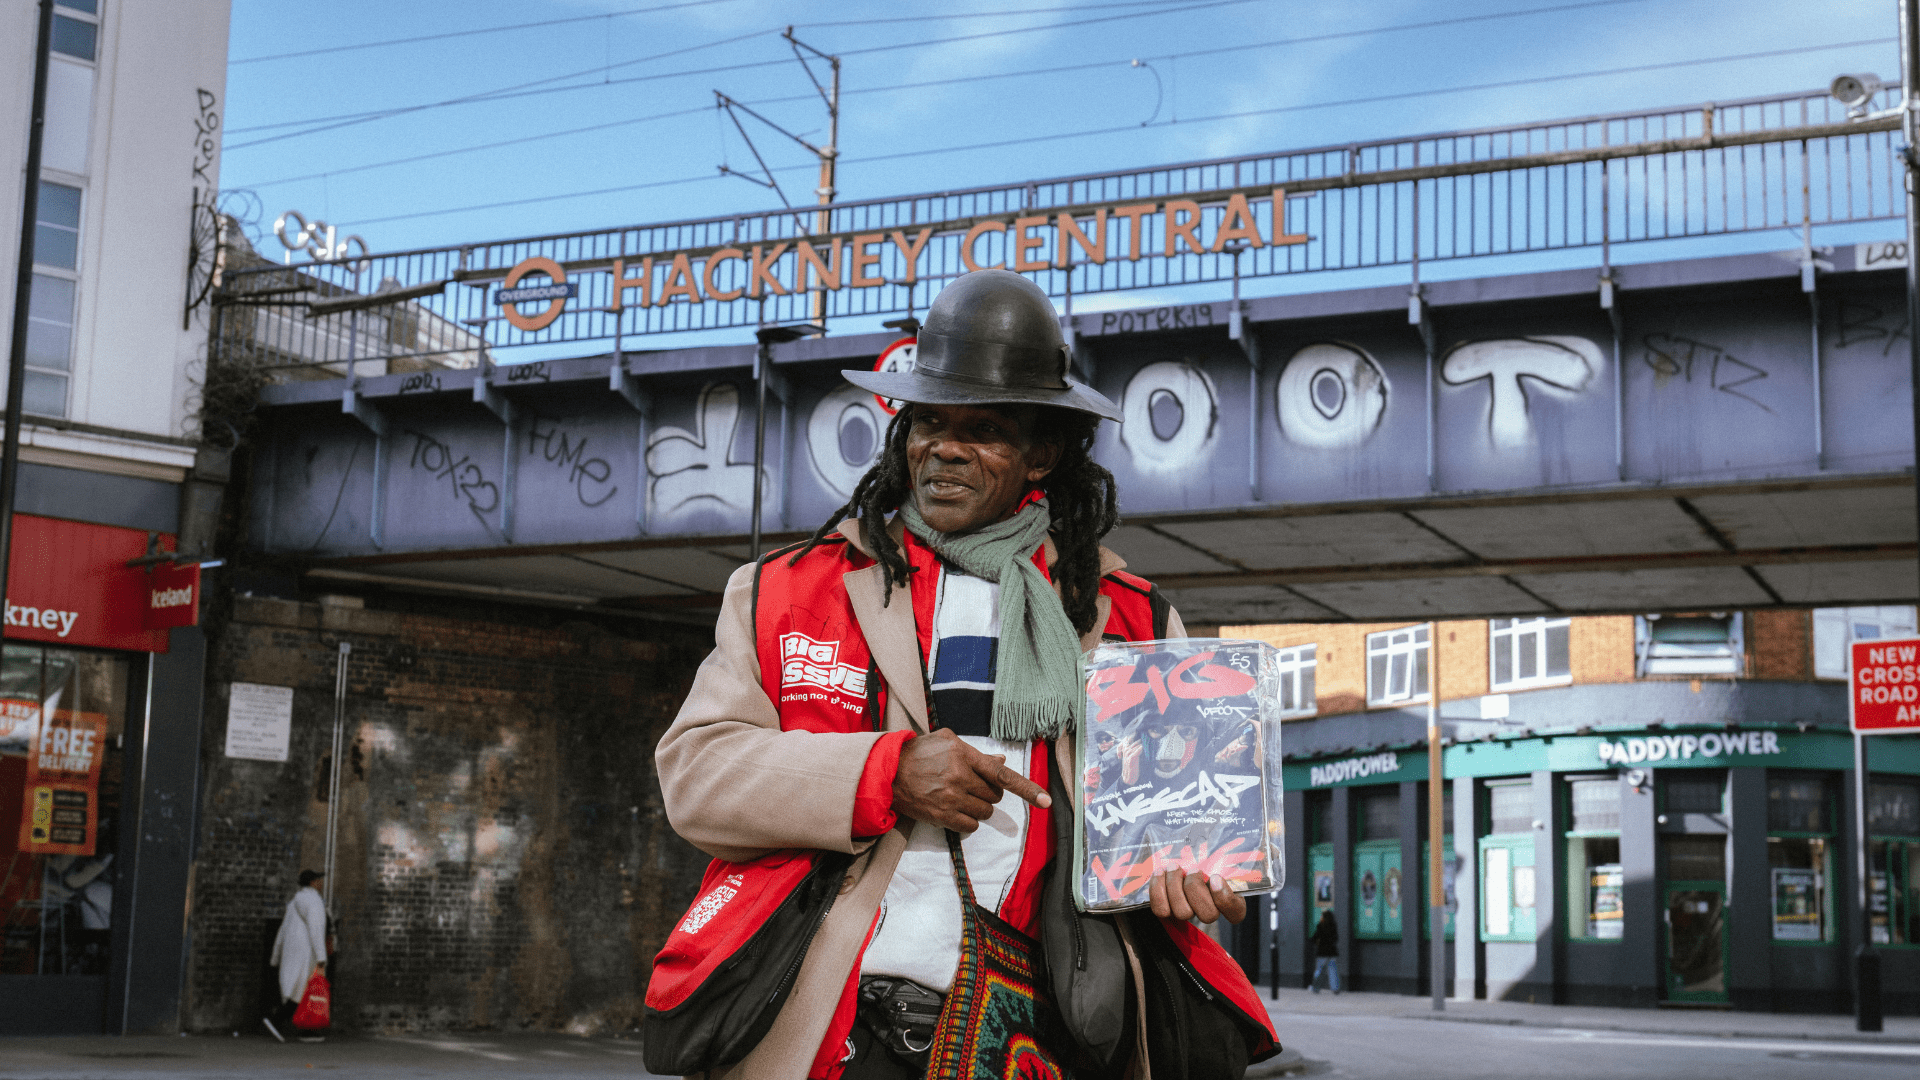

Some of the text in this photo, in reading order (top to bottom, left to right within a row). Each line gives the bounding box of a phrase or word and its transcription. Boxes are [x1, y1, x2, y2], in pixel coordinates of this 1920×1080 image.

[611, 188, 1308, 311] HACKNEY CENTRAL
[499, 284, 568, 301] OVERGROUND
[151, 584, 192, 609] Iceland
[3, 598, 79, 637] kney
[785, 637, 834, 663] BIG
[1229, 652, 1251, 669] £5
[1869, 646, 1917, 665] NEW
[785, 662, 866, 693] SSUE
[1086, 651, 1257, 723] BIG
[1858, 665, 1920, 686] CROS
[781, 692, 808, 702] orking
[1860, 685, 1918, 704] ROAD
[1896, 705, 1920, 722] AH
[39, 727, 96, 757] FREE
[1598, 731, 1780, 765] PADDYPOWER
[38, 754, 92, 773] DELIVERY
[1311, 752, 1399, 787] PADDYPOWER
